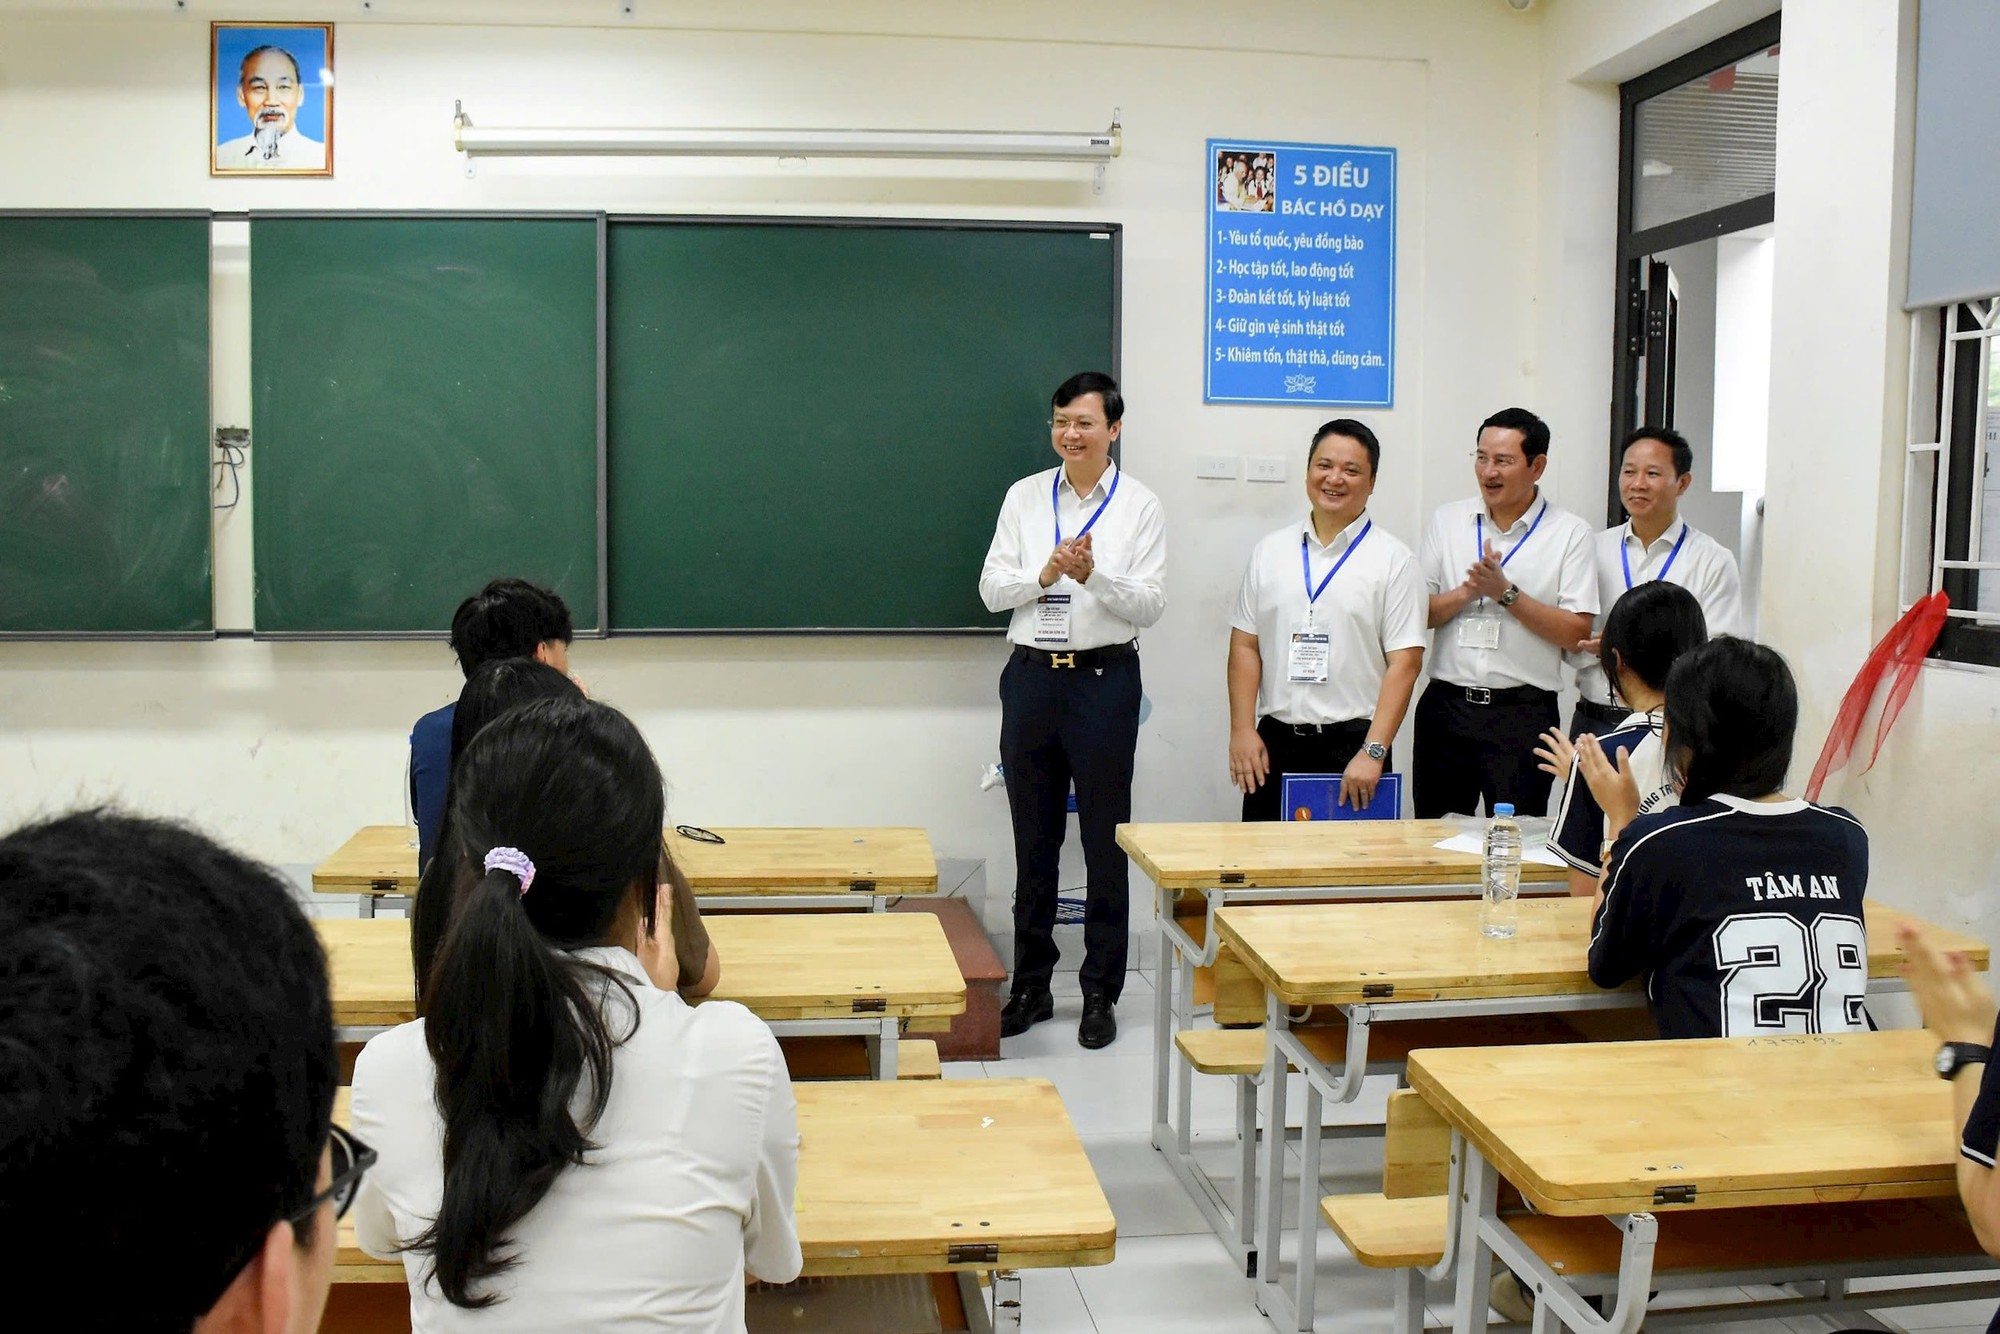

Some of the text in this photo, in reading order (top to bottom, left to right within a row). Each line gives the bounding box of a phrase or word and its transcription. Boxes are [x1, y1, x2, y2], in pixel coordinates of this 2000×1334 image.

[1294, 161, 1369, 189] 5 ĐIỀU
[1282, 198, 1384, 222] BÁC HỒ DẠY
[1217, 230, 1228, 245] 1-
[1229, 230, 1248, 246] Yêu
[1263, 230, 1292, 251] quốc,
[1293, 232, 1313, 251] yêu
[1343, 234, 1364, 250] bào
[1216, 259, 1354, 282] 2- Học tập tốt, lao động tốt
[1215, 288, 1351, 311] 3- Đoàn kết tốt, kỷ luật tốt
[1215, 318, 1345, 340] 4- Giữ gìn vệ sinh thật tốt
[1215, 346, 1386, 370] 5- Khiêm tốn, thật thà, dũng cảm.
[1745, 871, 1841, 901] TÂM AN
[1711, 912, 1868, 1038] 28
